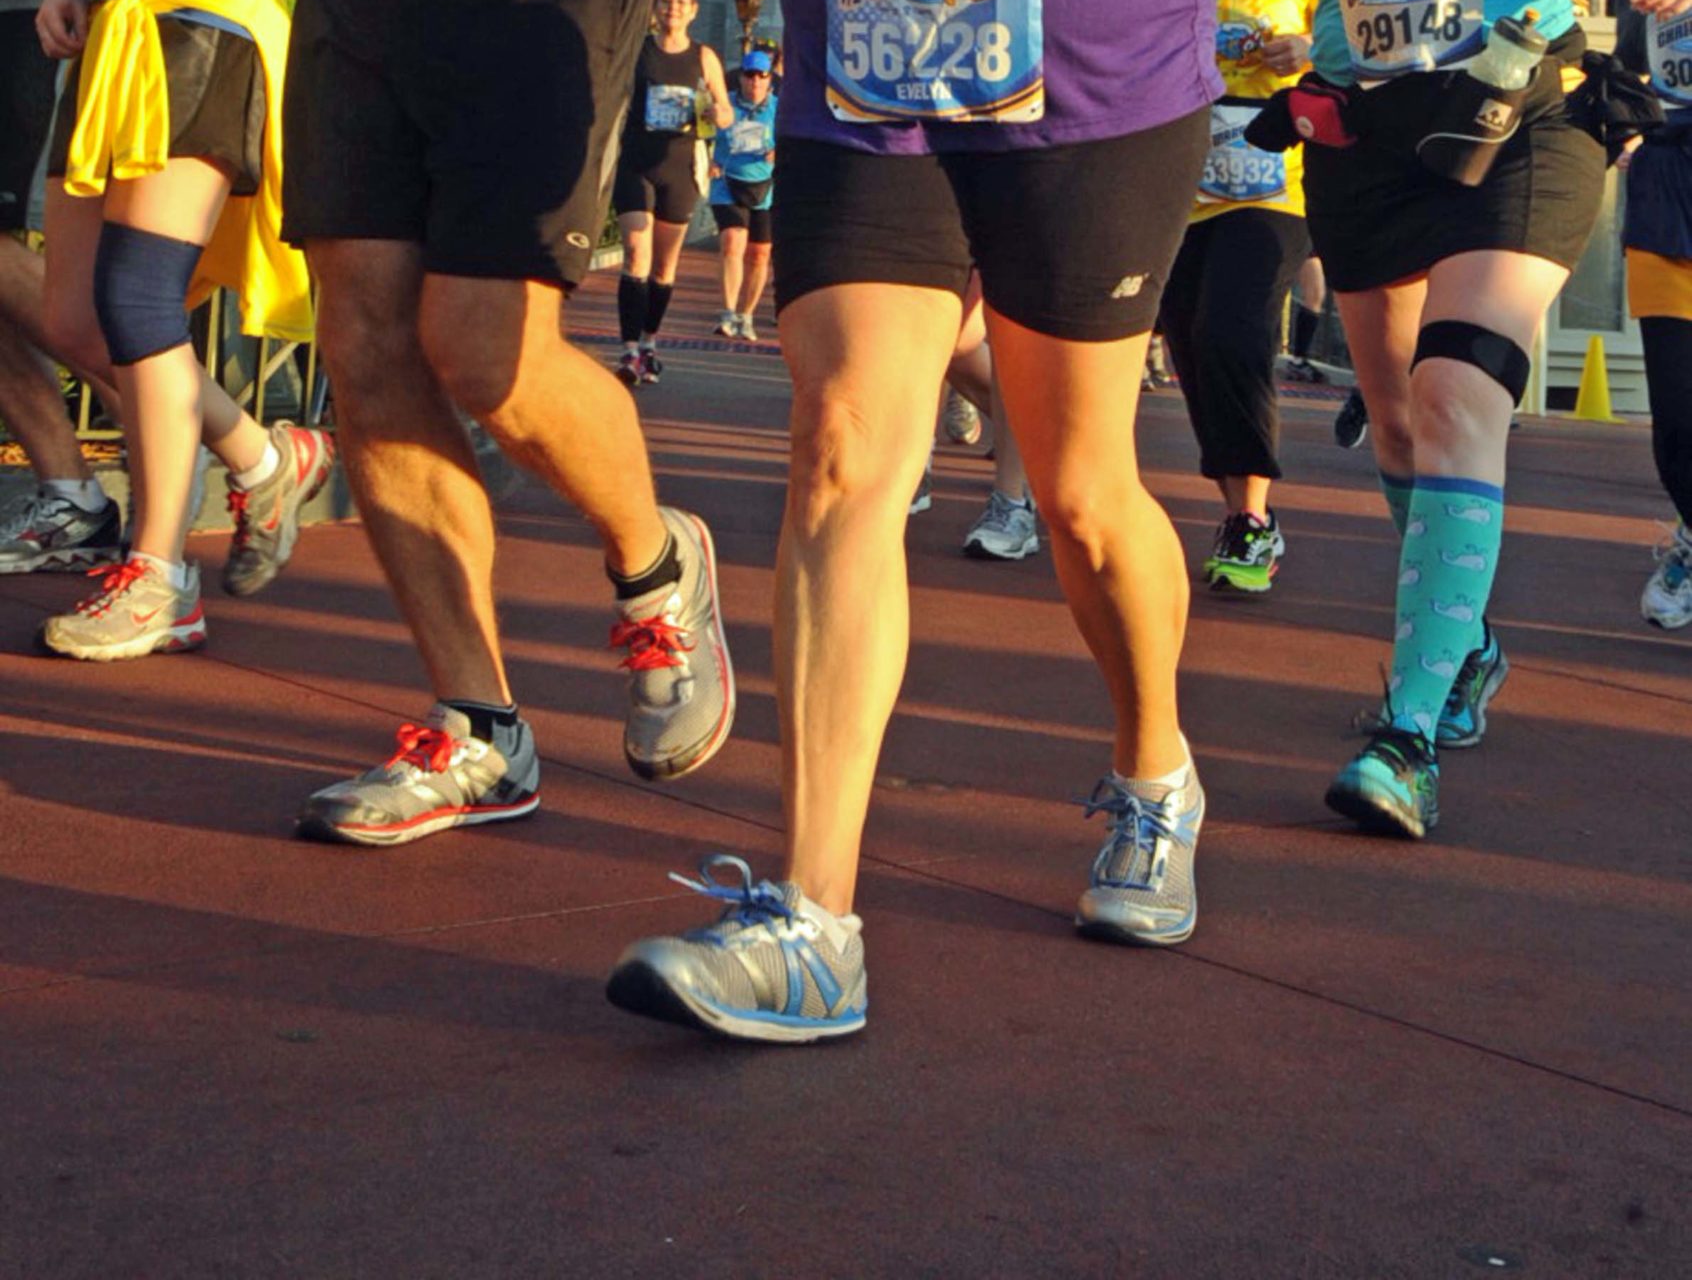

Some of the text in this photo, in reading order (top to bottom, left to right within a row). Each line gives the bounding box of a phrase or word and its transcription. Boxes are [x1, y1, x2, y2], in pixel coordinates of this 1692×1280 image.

[842, 21, 1012, 83] 56228
[1356, 2, 1462, 61] 29148
[1203, 157, 1276, 185] 53932
